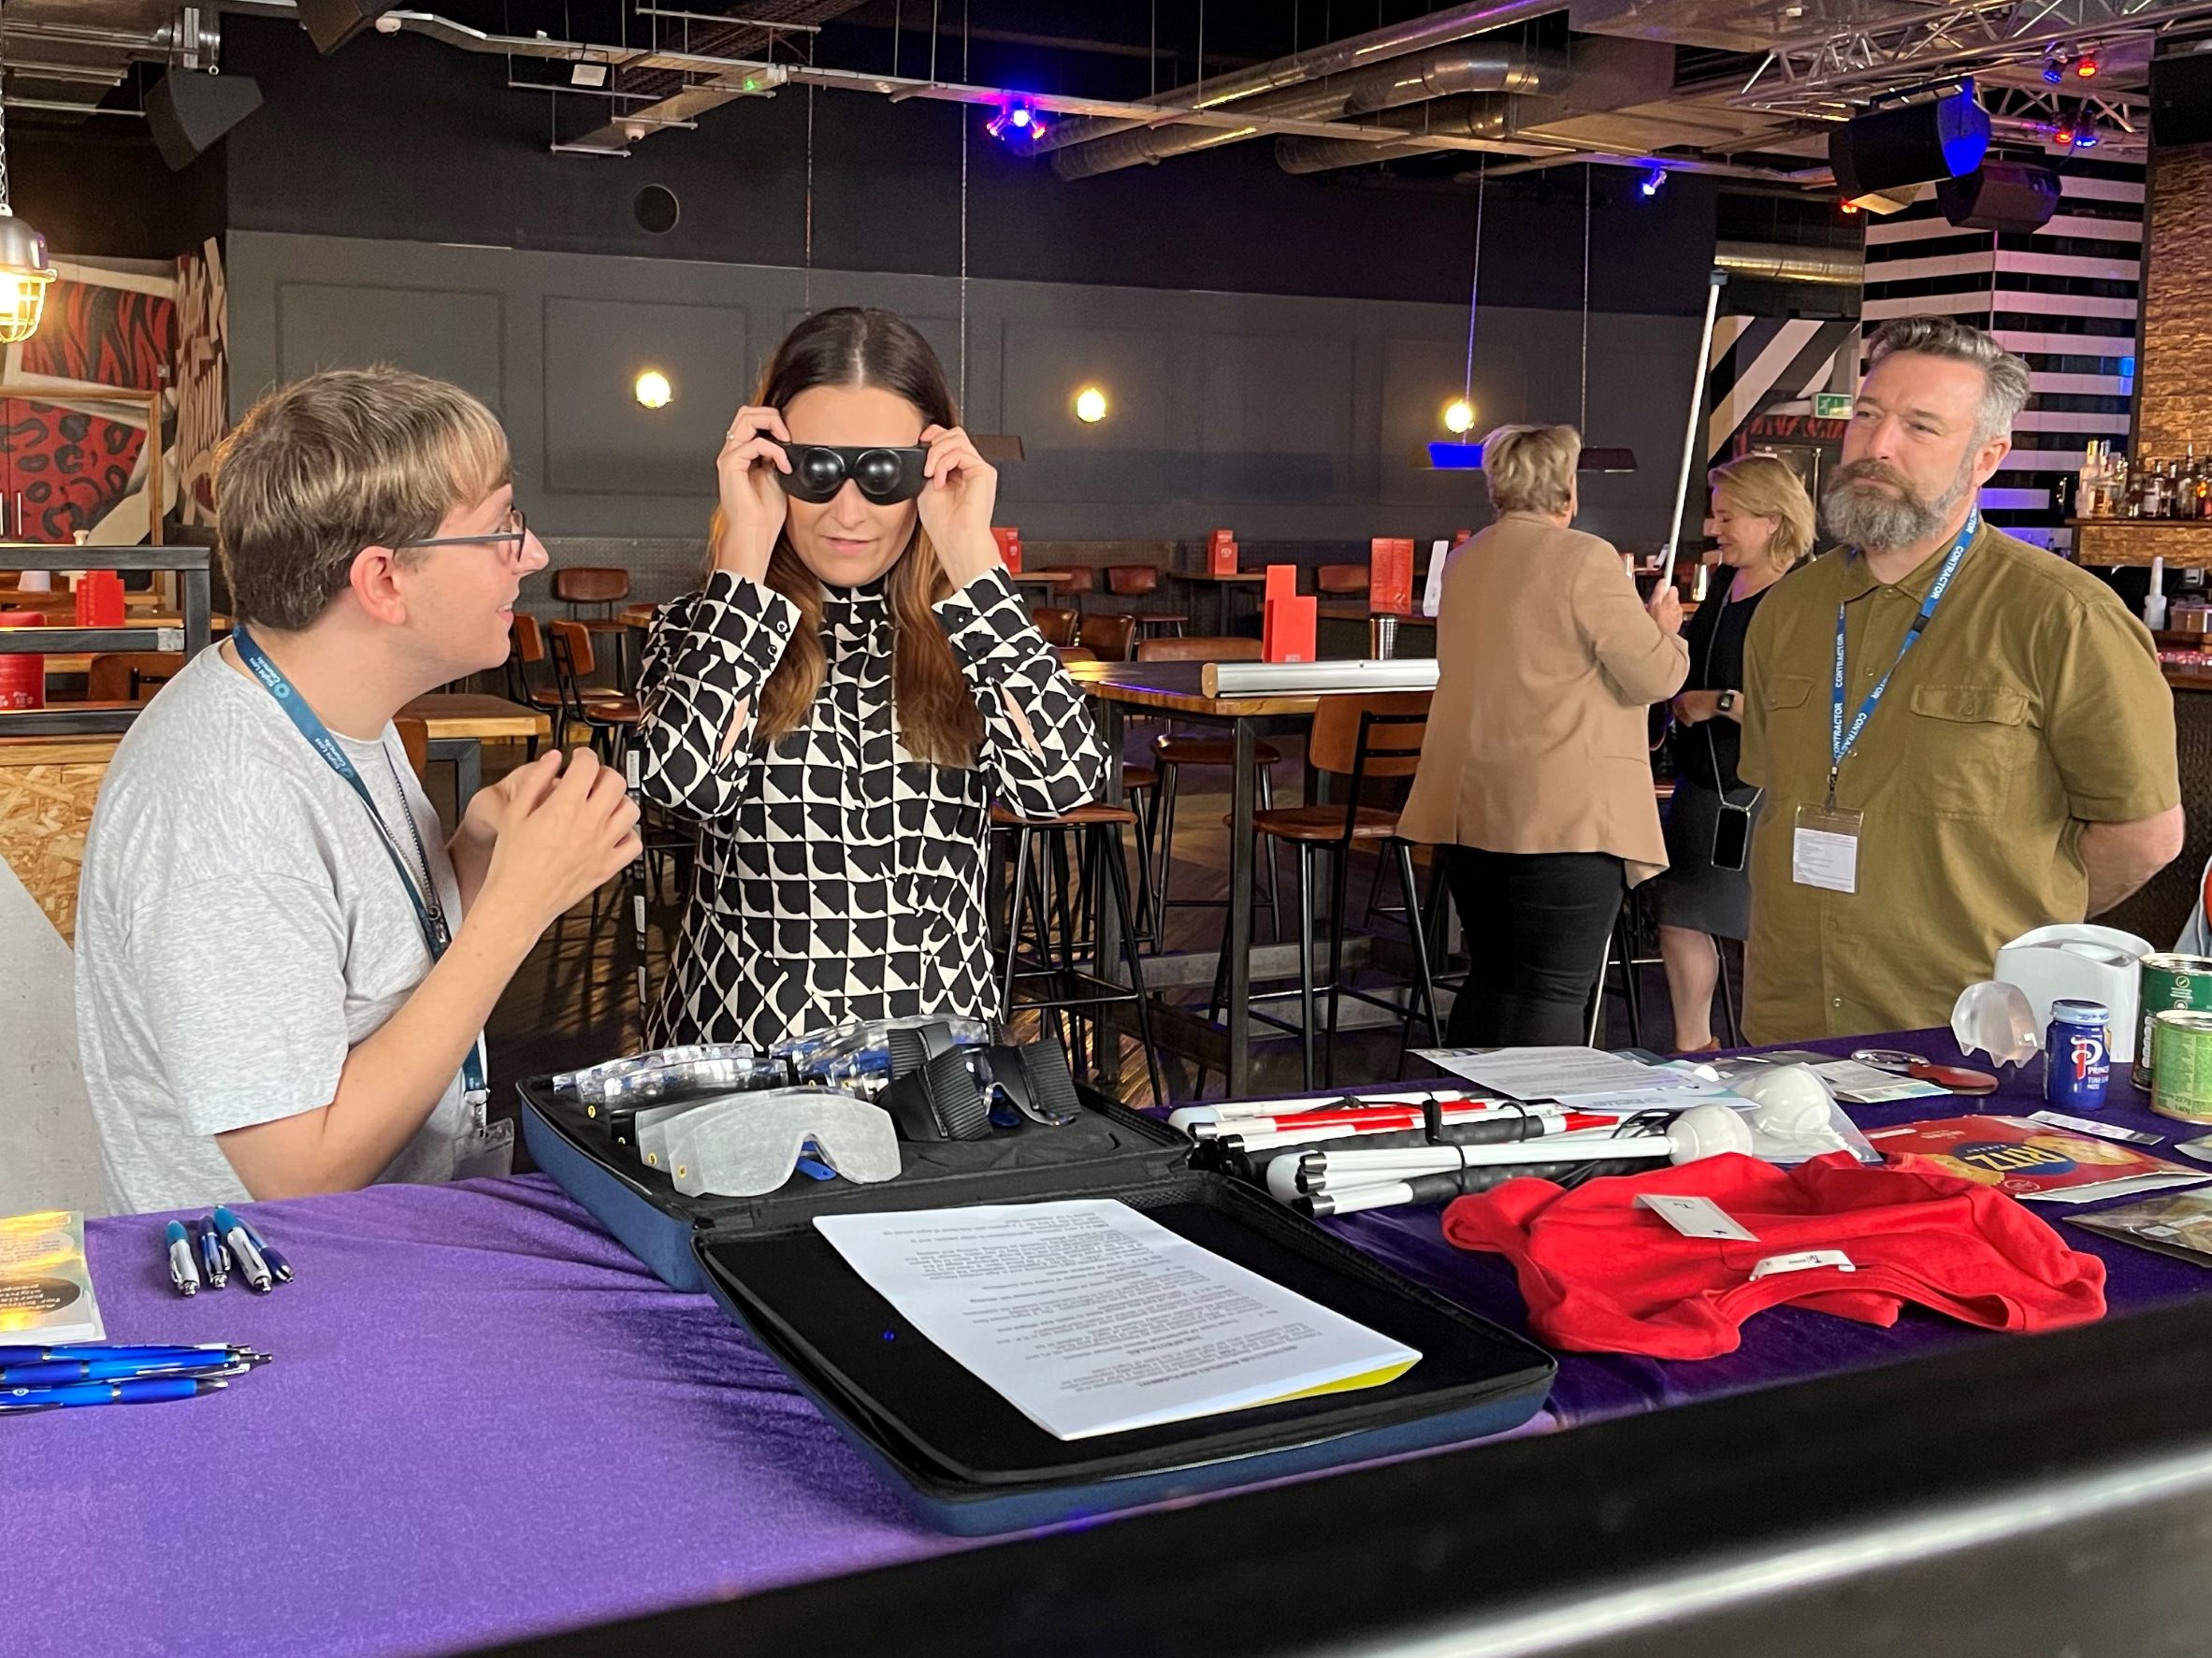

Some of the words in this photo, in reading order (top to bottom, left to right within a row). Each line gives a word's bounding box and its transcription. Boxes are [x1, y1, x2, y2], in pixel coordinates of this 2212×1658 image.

[1930, 545, 1964, 599] CONTRACTOR
[1835, 633, 1843, 687] CONTRACTOR
[1964, 1145, 2068, 1171] RITZ
